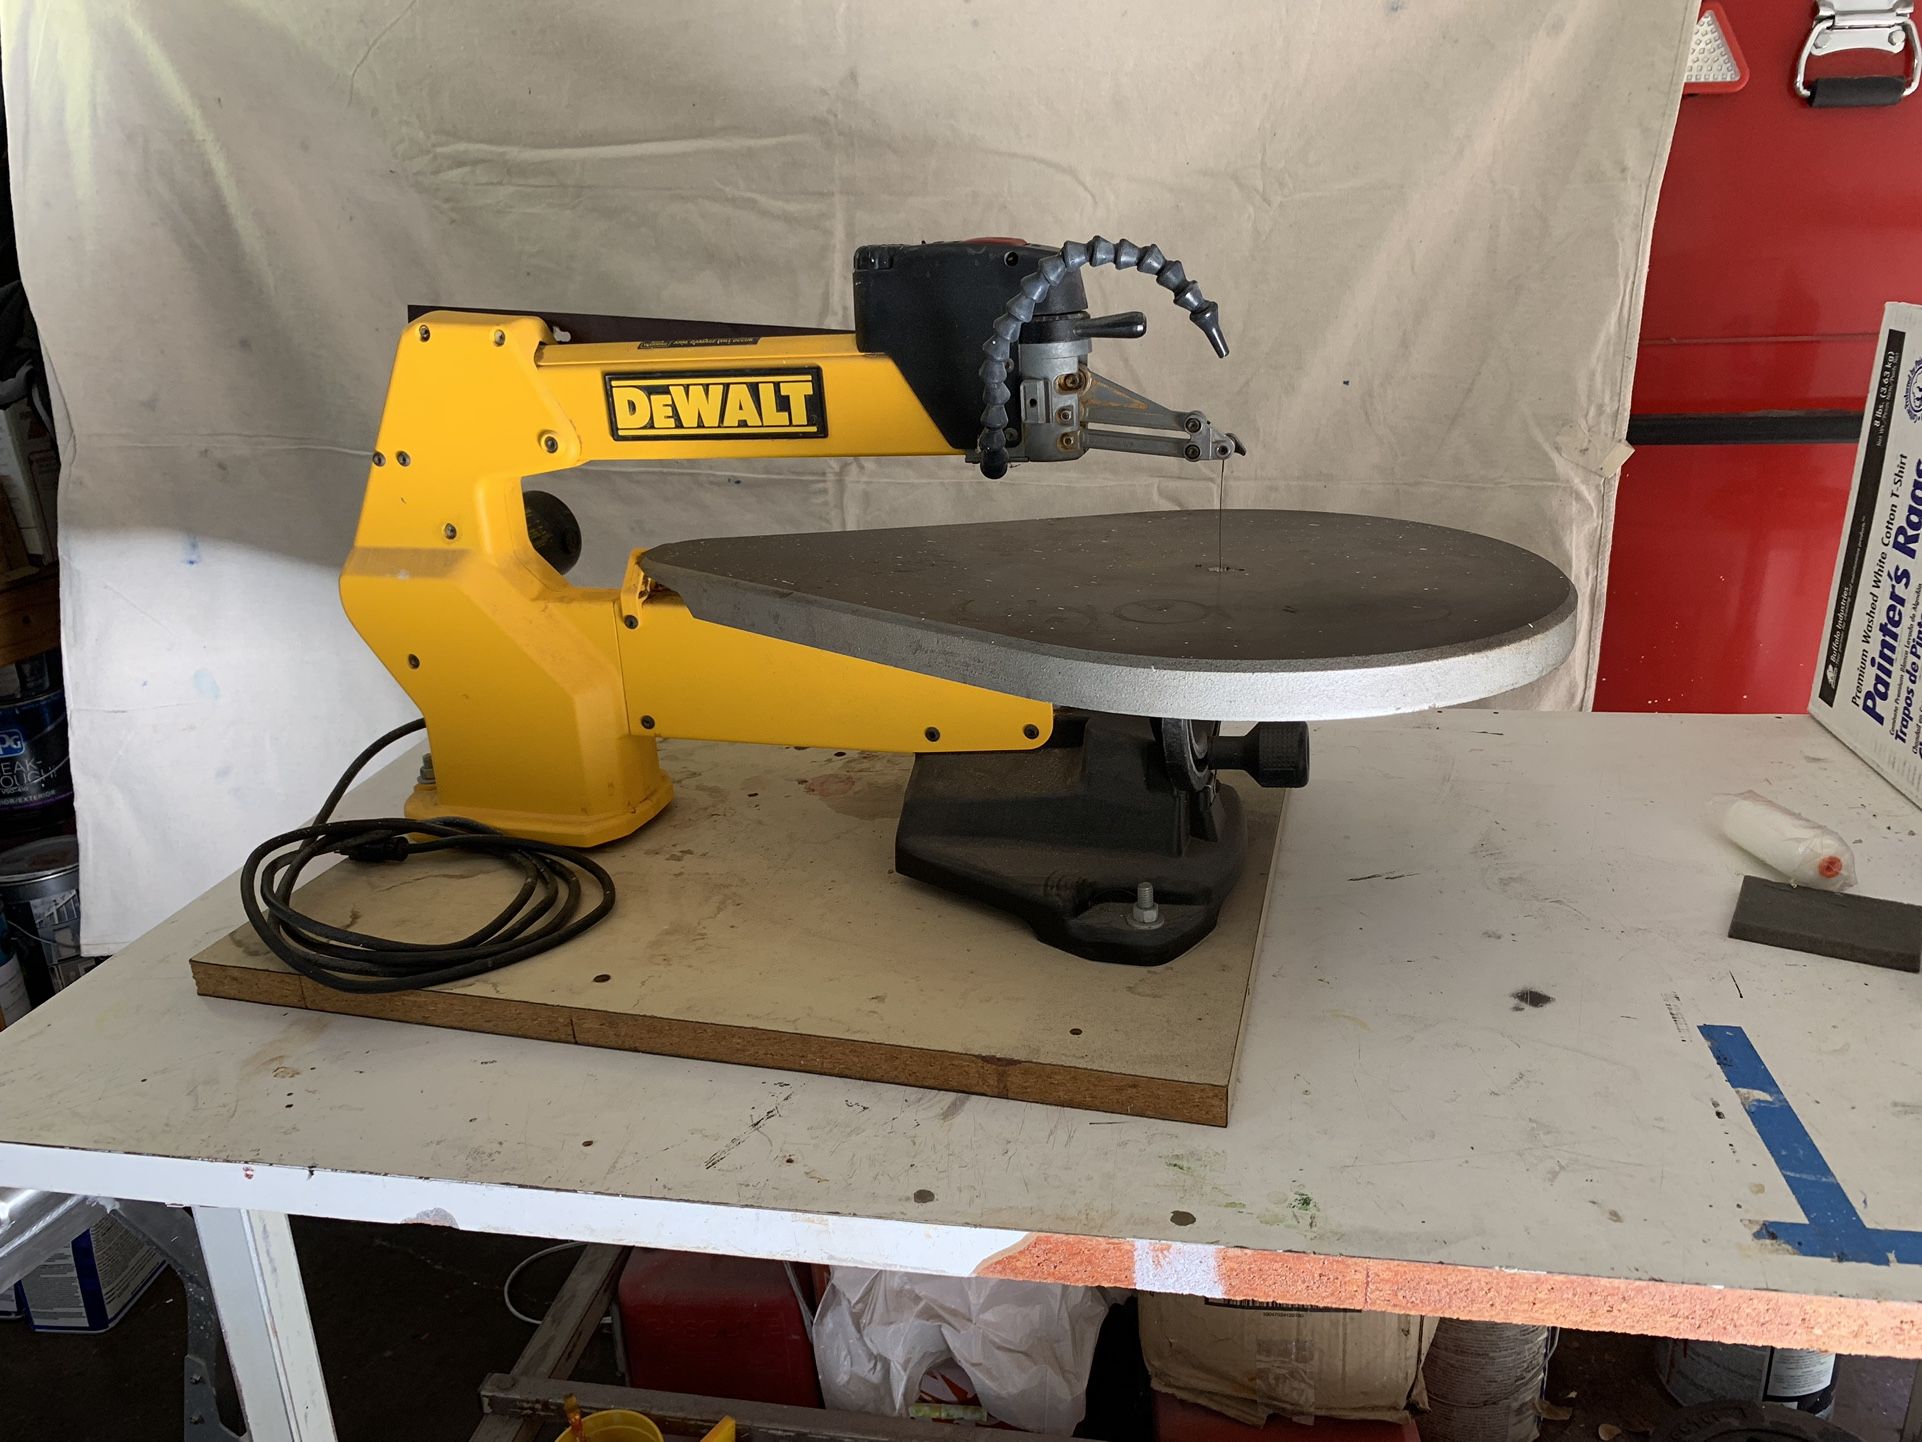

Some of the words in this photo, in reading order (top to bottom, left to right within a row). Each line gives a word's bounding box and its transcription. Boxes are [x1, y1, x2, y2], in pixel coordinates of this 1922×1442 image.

[1884, 350, 1895, 369] kg)
[1880, 371, 1890, 398] (3.63
[1875, 402, 1884, 419] lbs.
[1873, 418, 1881, 429] 8
[1852, 649, 1868, 707] Premium
[1862, 592, 1878, 644] Washed
[1872, 552, 1887, 588] White
[1882, 504, 1897, 547] Cotton
[1891, 453, 1907, 499] T-Shirt
[1831, 631, 1840, 662] Buffalo
[1836, 587, 1848, 629] Industries
[1862, 565, 1910, 726] Painter's
[1910, 614, 1922, 660] Pint
[1906, 662, 1919, 684] de
[1895, 687, 1914, 744] Trapos
[0, 735, 21, 754] PG
[0, 758, 42, 775] EAK-
[0, 764, 57, 788] OUGH!
[0, 789, 56, 805] IOR/EXTERIOR
